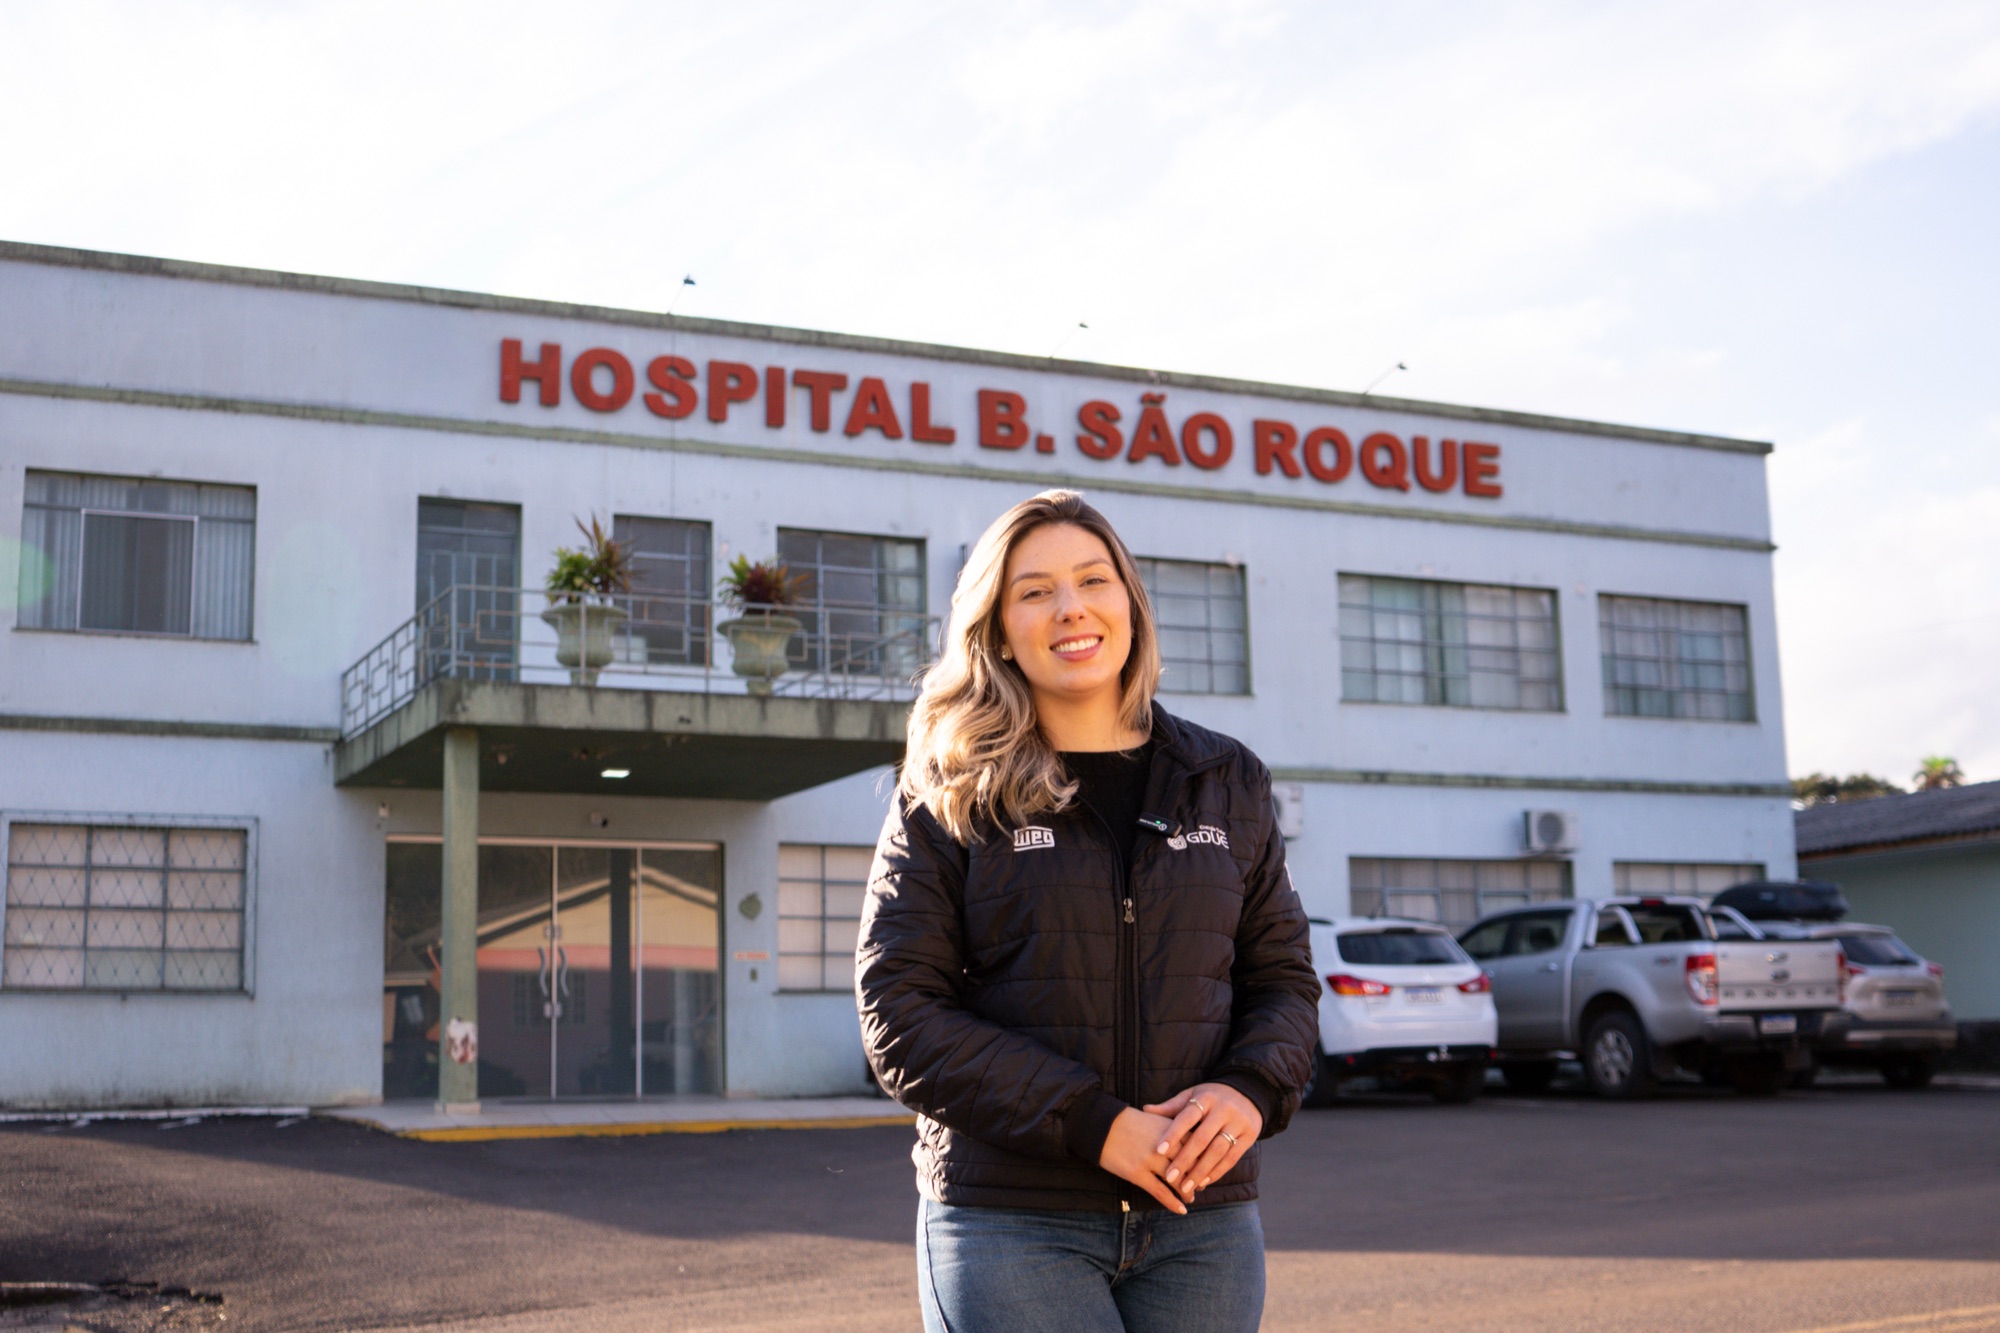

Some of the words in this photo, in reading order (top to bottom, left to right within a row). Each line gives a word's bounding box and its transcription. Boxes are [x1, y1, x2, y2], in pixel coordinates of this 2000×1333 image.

[500, 338, 955, 444] HOSPITAL
[977, 388, 1055, 454] B.
[1076, 392, 1234, 470] SÃO
[1253, 418, 1503, 498] ROQUE
